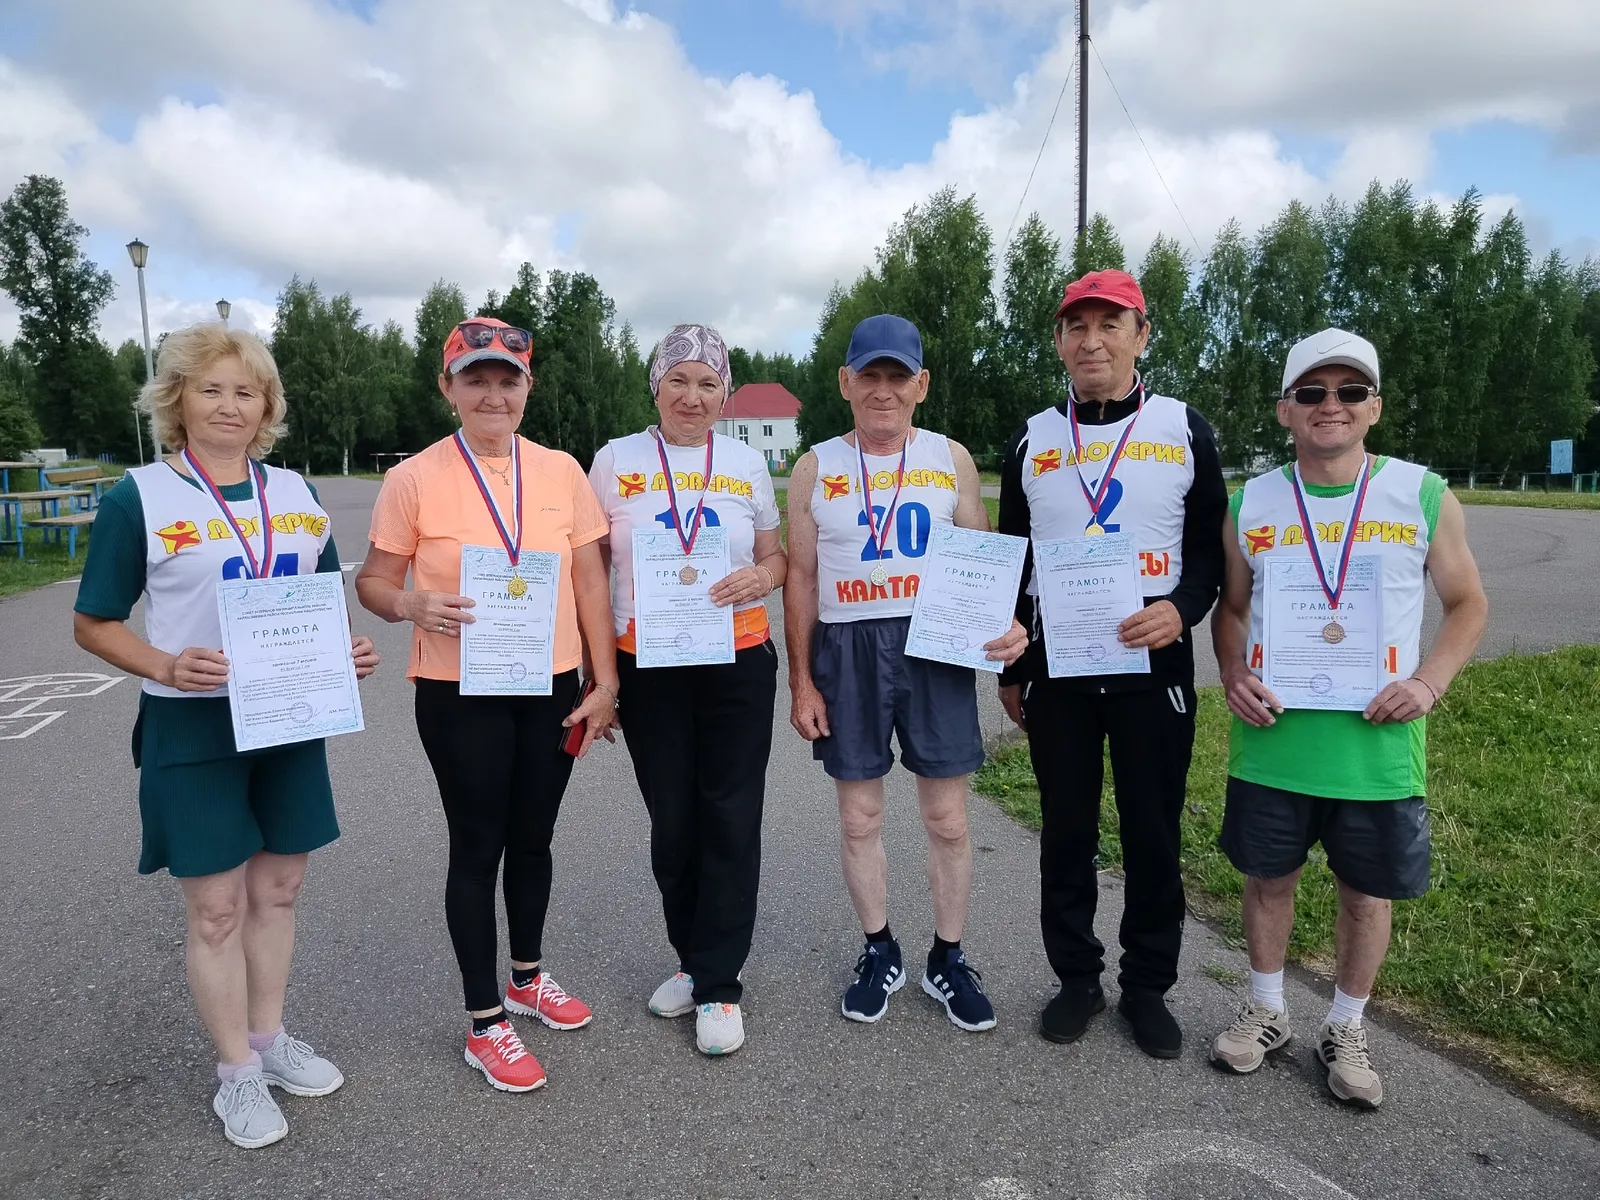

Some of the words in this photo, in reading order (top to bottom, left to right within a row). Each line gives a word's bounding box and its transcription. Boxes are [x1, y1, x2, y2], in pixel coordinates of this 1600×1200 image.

[857, 502, 931, 562] 20
[656, 568, 708, 578] ГРАА
[944, 567, 996, 582] ГРАМОТА
[836, 574, 920, 603] КАЛТА
[1061, 576, 1115, 589] ГРАМОТА
[252, 624, 319, 639] ГРАМОТА
